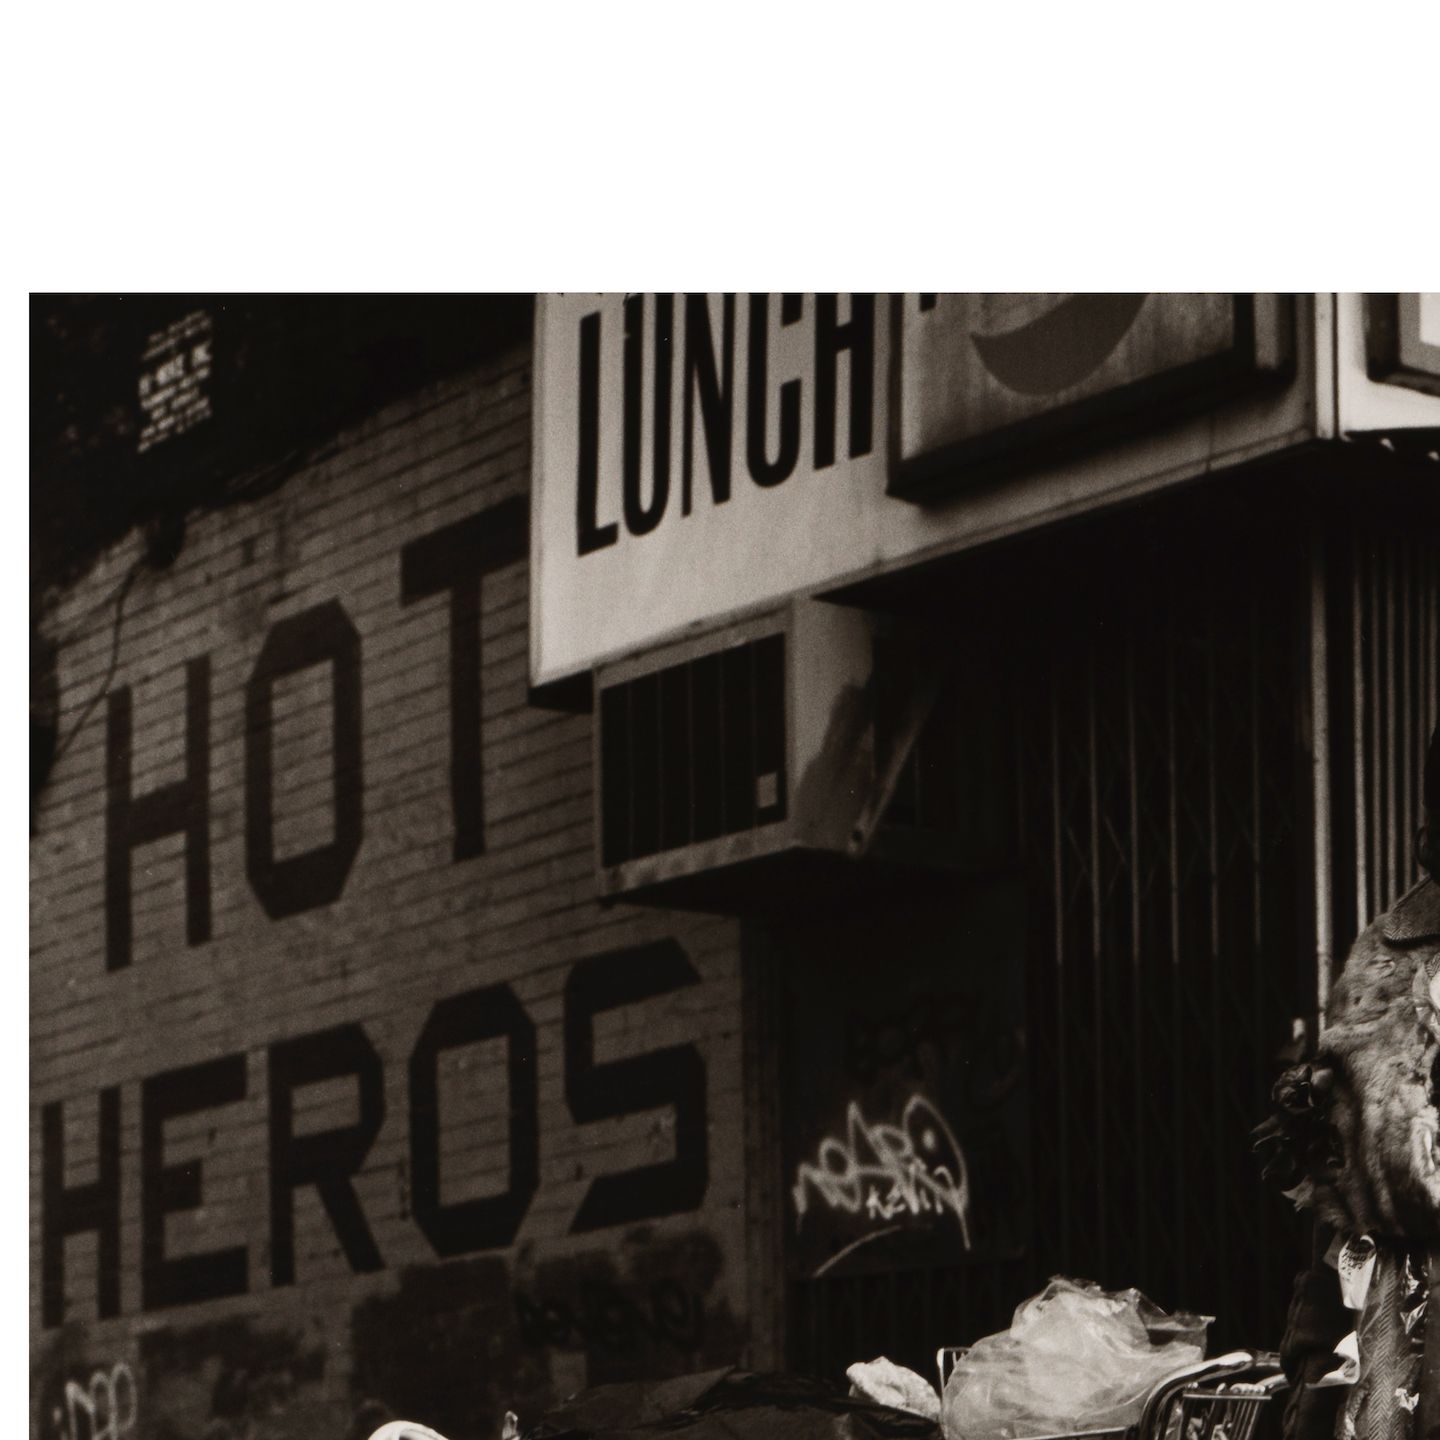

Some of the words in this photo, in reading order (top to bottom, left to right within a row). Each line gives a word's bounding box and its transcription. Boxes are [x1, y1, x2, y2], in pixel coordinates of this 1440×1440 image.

[576, 292, 876, 557] LUNCH
[105, 492, 529, 973] HOT
[41, 935, 709, 1329] HEROS
